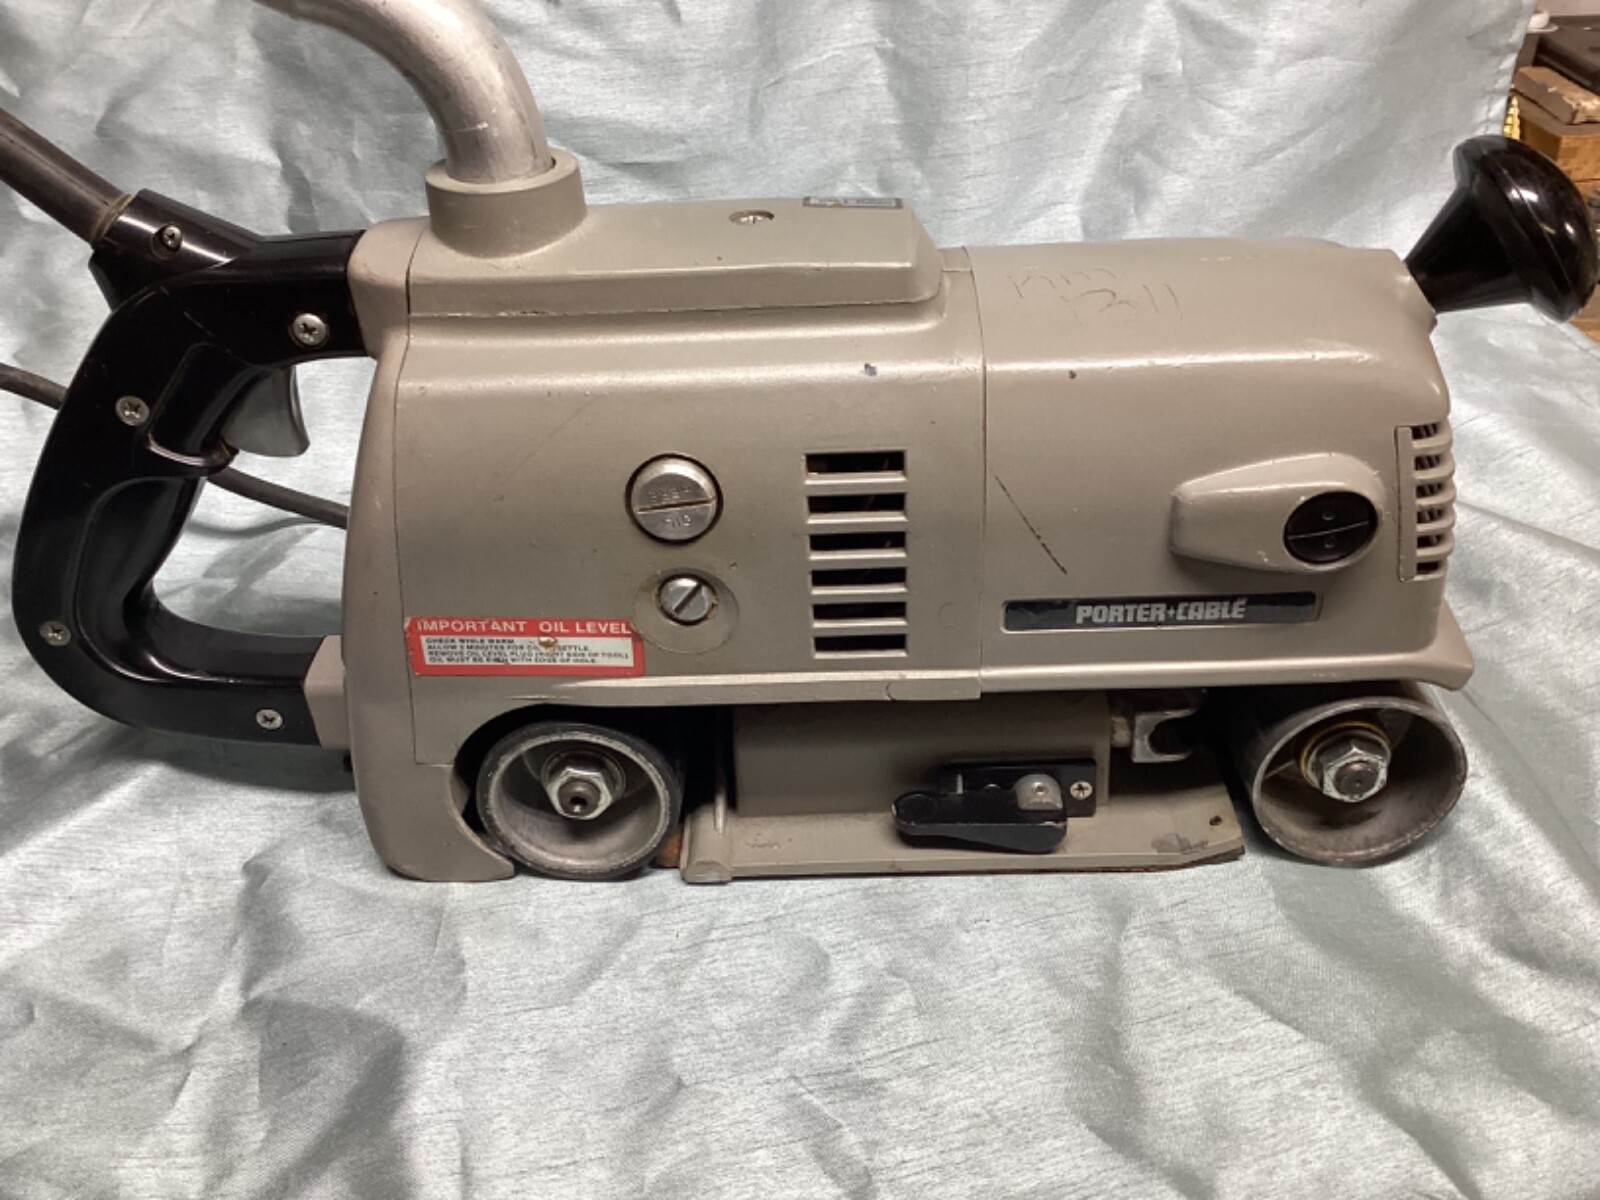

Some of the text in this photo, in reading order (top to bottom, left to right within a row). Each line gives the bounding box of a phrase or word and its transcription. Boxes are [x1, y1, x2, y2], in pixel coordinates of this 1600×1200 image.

[417, 619, 632, 634] IMPORTANT OIL LEVEL
